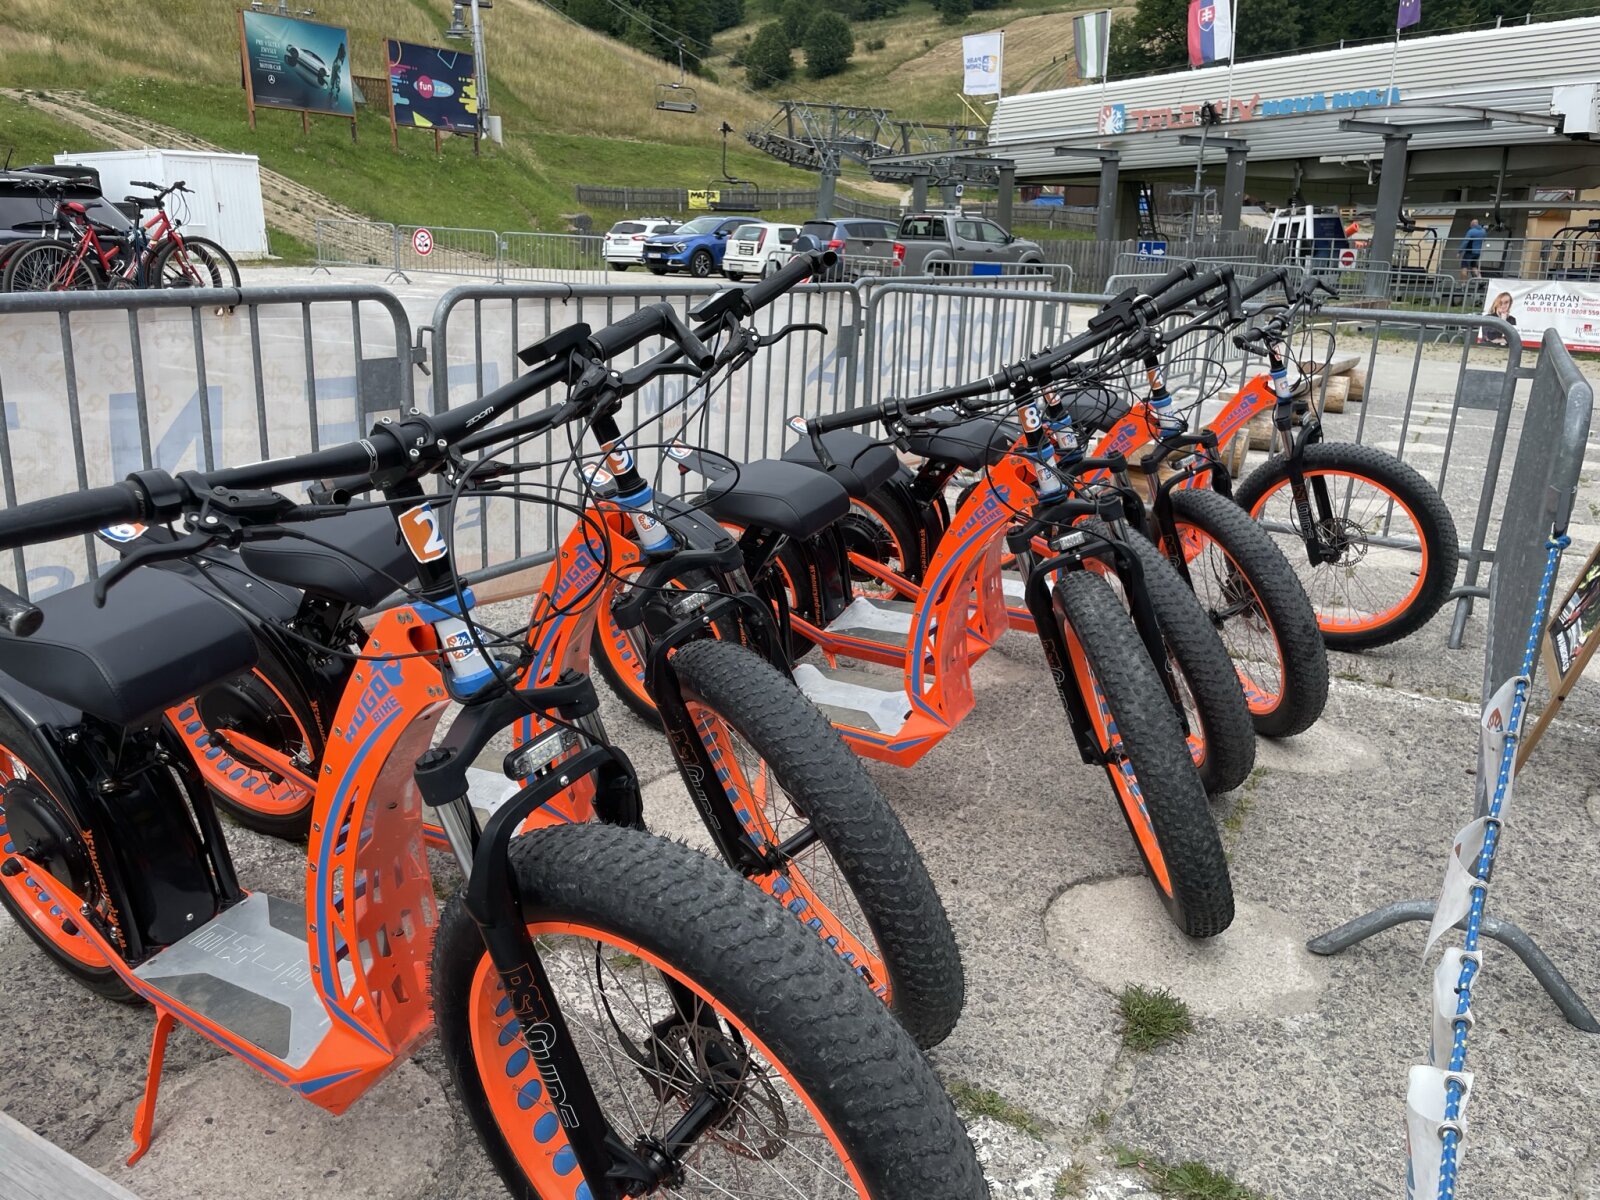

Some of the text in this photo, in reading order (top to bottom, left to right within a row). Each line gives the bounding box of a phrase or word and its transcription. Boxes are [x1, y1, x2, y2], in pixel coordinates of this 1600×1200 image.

[419, 81, 433, 91] fun
[1524, 294, 1580, 302] APARTMÁN
[1024, 406, 1040, 429] 8
[609, 443, 630, 471] 9
[980, 508, 1003, 527] BIKE
[414, 510, 446, 554] 2
[574, 568, 600, 592] BIKE
[344, 673, 391, 745] HUGO
[370, 695, 401, 724] BIKE
